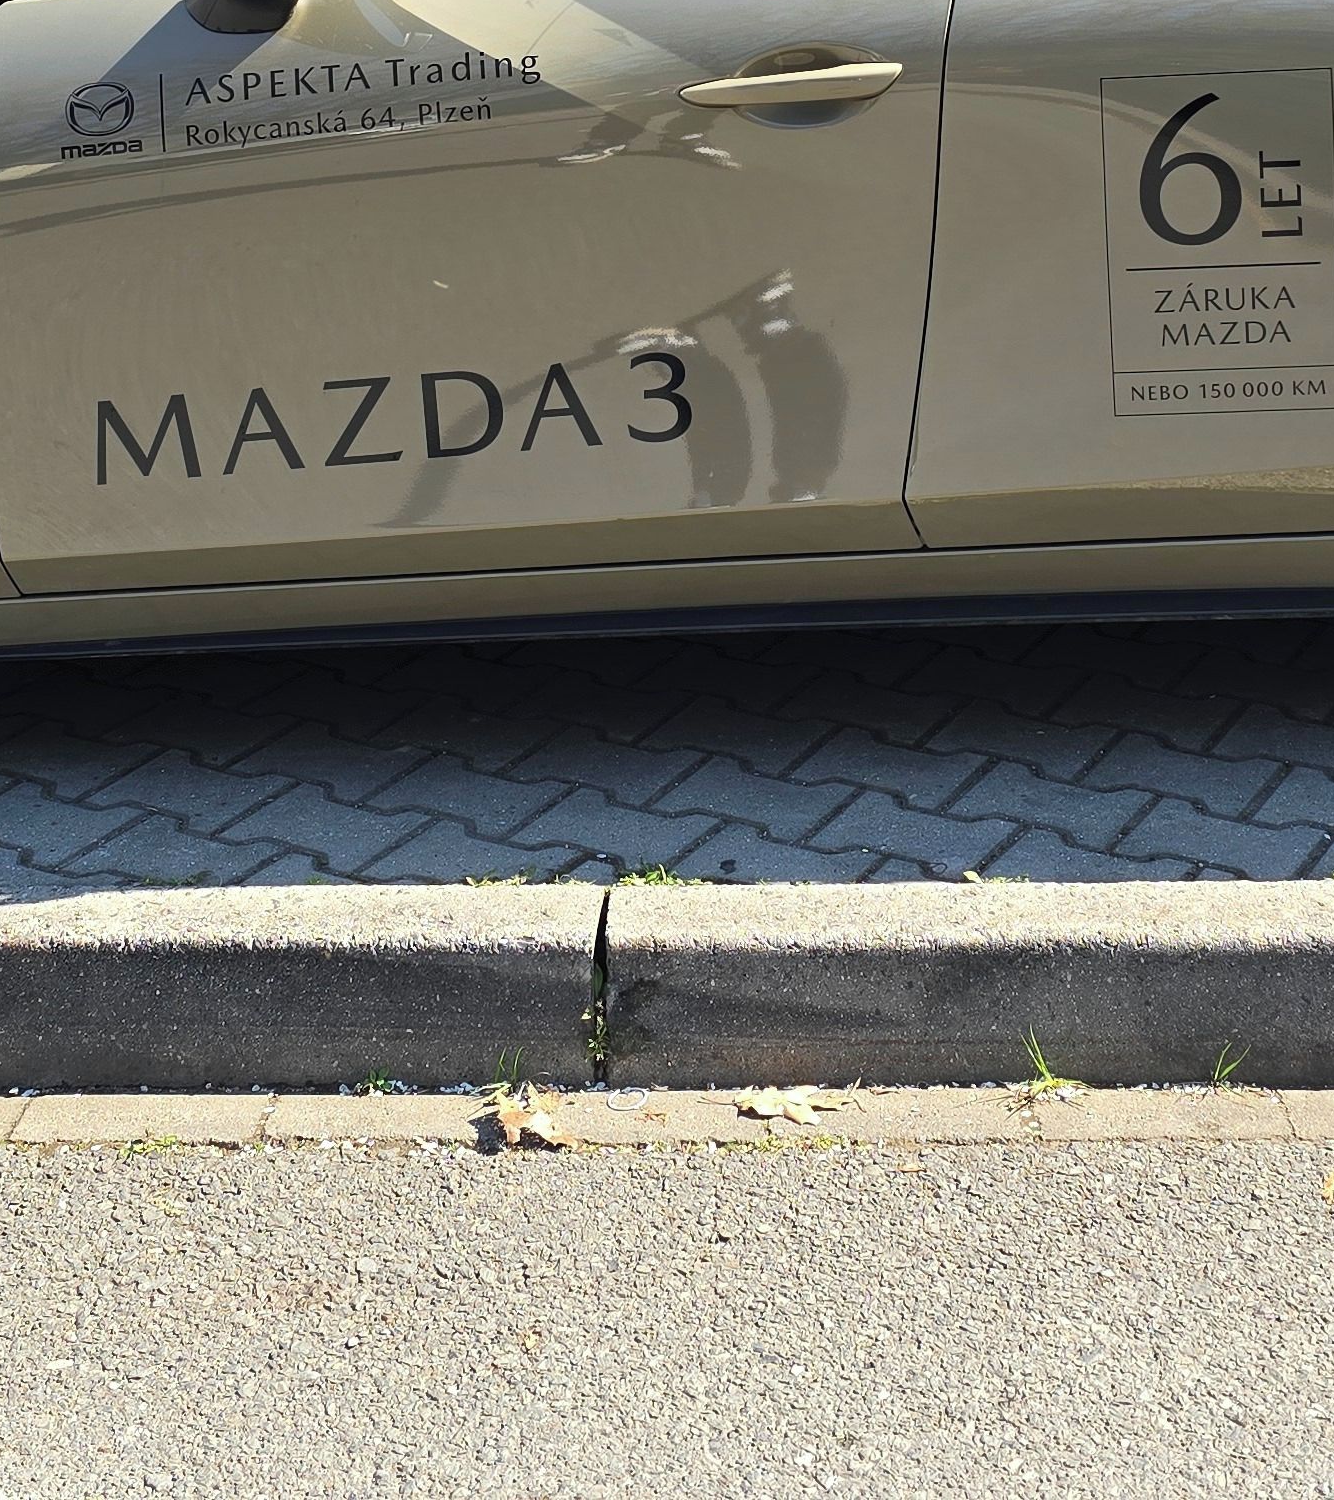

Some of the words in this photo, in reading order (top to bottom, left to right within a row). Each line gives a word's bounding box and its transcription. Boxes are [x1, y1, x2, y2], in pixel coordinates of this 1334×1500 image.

[185, 61, 371, 106] ASPEKTA
[385, 51, 541, 86] Trading
[60, 138, 143, 160] mazda
[185, 109, 347, 150] Rokycanská
[360, 106, 407, 133] 64,
[419, 97, 493, 127] Plzeň
[1139, 92, 1243, 246] 6
[1258, 150, 1303, 238] LET
[1153, 282, 1296, 314] ZÁRUKA
[1161, 320, 1292, 347] MAZDA
[1130, 384, 1189, 401] NEBO
[1198, 382, 1236, 399] 150
[1242, 381, 1284, 398] 000
[1292, 379, 1327, 396] KM
[96, 351, 693, 486] MAZDA3
